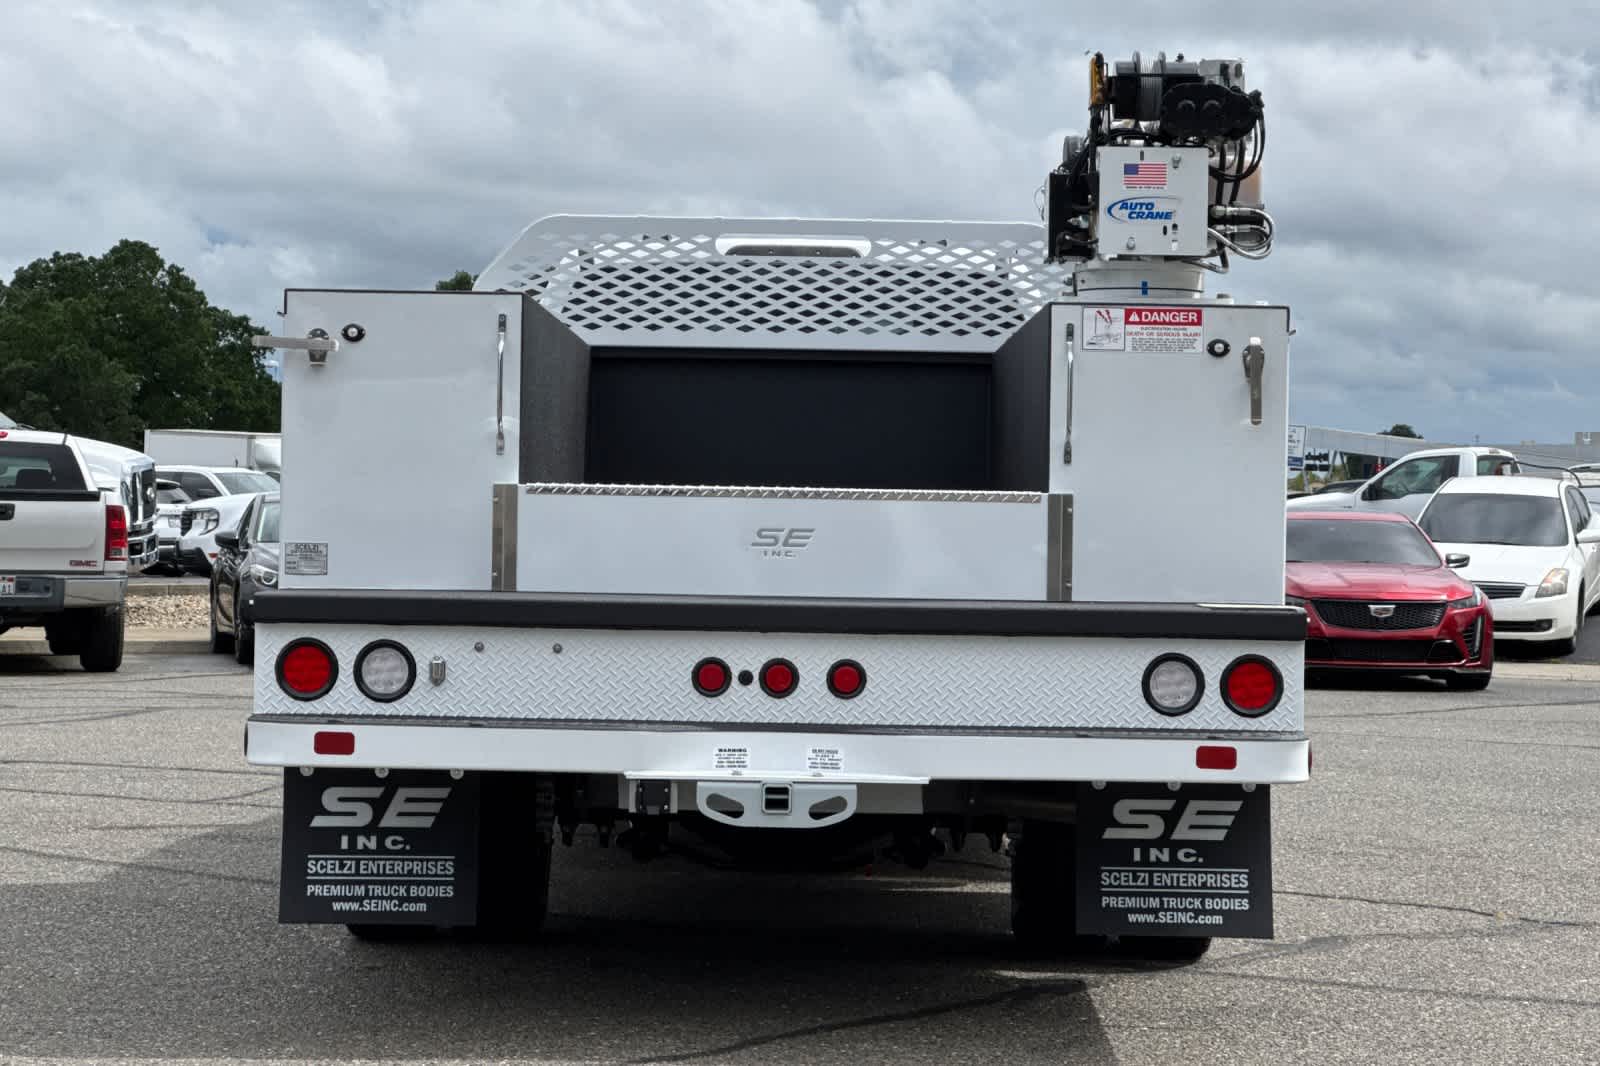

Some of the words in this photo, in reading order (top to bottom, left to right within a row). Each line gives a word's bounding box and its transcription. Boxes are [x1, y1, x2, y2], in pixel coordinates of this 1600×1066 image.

[1119, 202, 1155, 211] AUTO
[1127, 211, 1173, 220] CRANE
[1141, 311, 1198, 322] DANGER
[751, 528, 816, 547] SE
[69, 559, 97, 568] GMC
[309, 786, 452, 828] SE
[1102, 798, 1244, 841] SE
[340, 834, 411, 850] INC.
[1133, 847, 1204, 863] INC.
[307, 860, 356, 874] SCELZI
[359, 860, 455, 875] ENTERPRISES
[1100, 871, 1149, 886] SCELZI
[1153, 872, 1249, 888] ENTERPRISES
[306, 884, 365, 897] PREMIUM
[368, 885, 407, 897] TRUCK
[410, 885, 454, 898] BODIES
[332, 900, 427, 912] www.SEINC.com
[1101, 896, 1160, 909] PREMIUM
[1162, 897, 1202, 909] TRUCK
[1205, 898, 1250, 911] BODIES
[1127, 911, 1223, 925] www.SEINC.com
